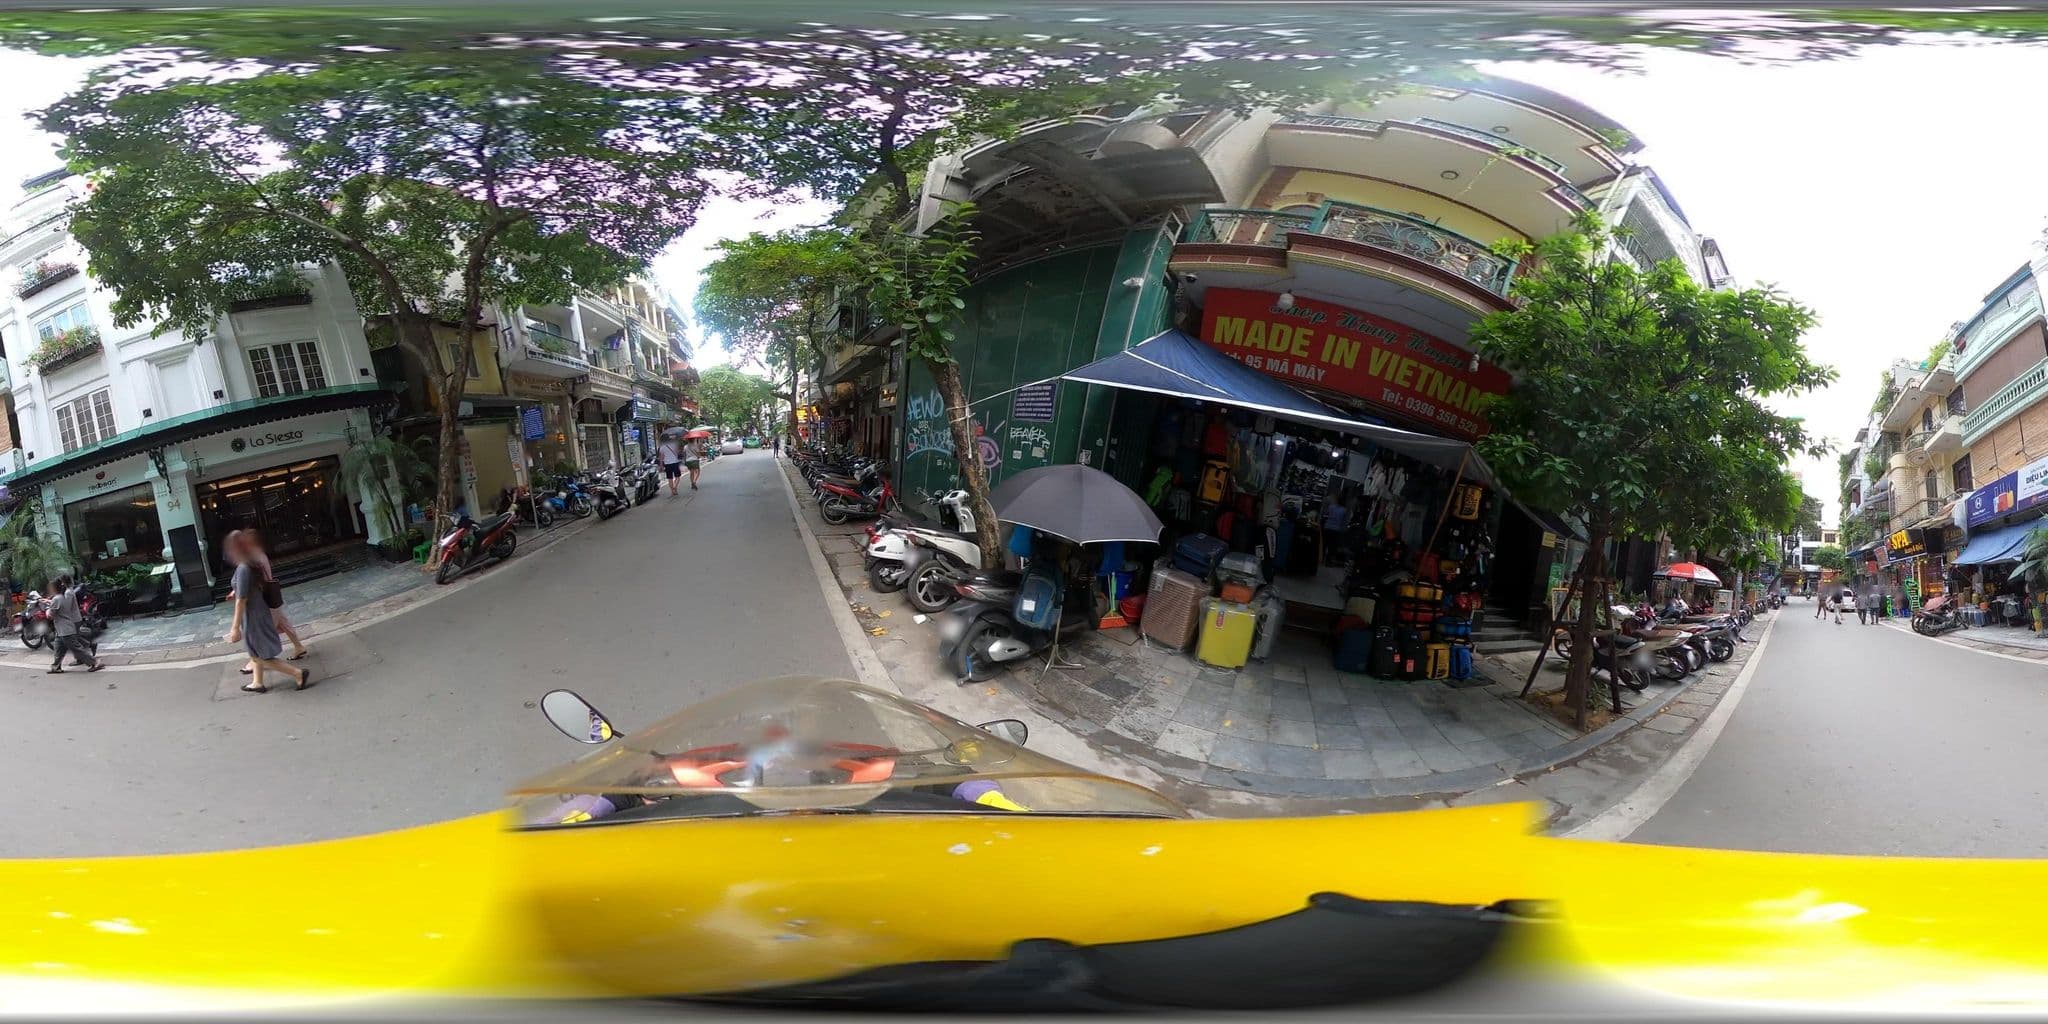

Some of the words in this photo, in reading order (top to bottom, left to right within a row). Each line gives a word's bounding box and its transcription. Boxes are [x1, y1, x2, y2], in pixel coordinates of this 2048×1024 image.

[1213, 316, 1314, 358] MADE
[1321, 334, 1361, 370] IN
[1368, 346, 1486, 416] VIETNAM
[1245, 354, 1263, 369] 95
[1382, 387, 1404, 405] Tel:
[250, 437, 264, 447] La
[265, 430, 303, 445] Siesta
[167, 499, 181, 512] 94
[1891, 530, 1909, 550] SPA
